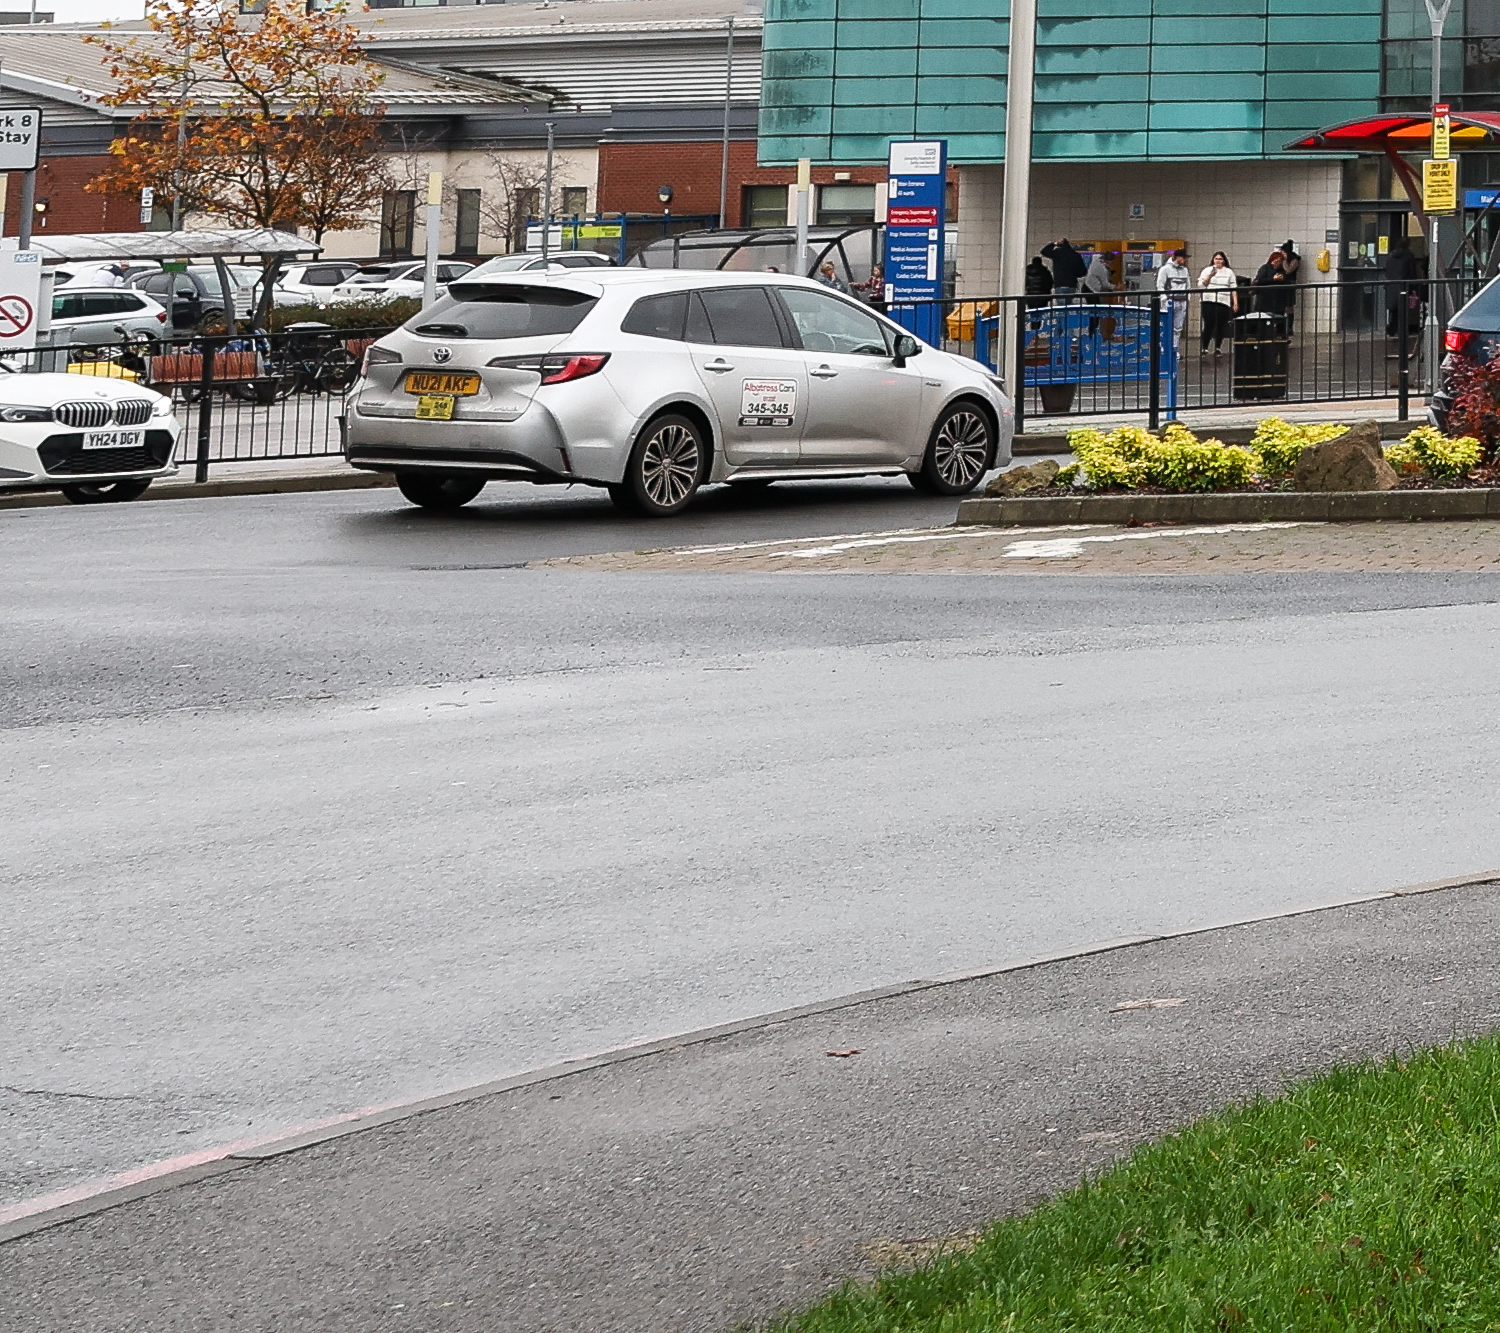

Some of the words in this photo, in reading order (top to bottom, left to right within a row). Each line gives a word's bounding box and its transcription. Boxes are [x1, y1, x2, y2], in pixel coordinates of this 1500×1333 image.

[21, 115, 32, 127] 8
[779, 384, 795, 393] Cars
[748, 403, 789, 414] 345-345
[88, 433, 119, 447] YH24
[120, 431, 142, 445] DGV
